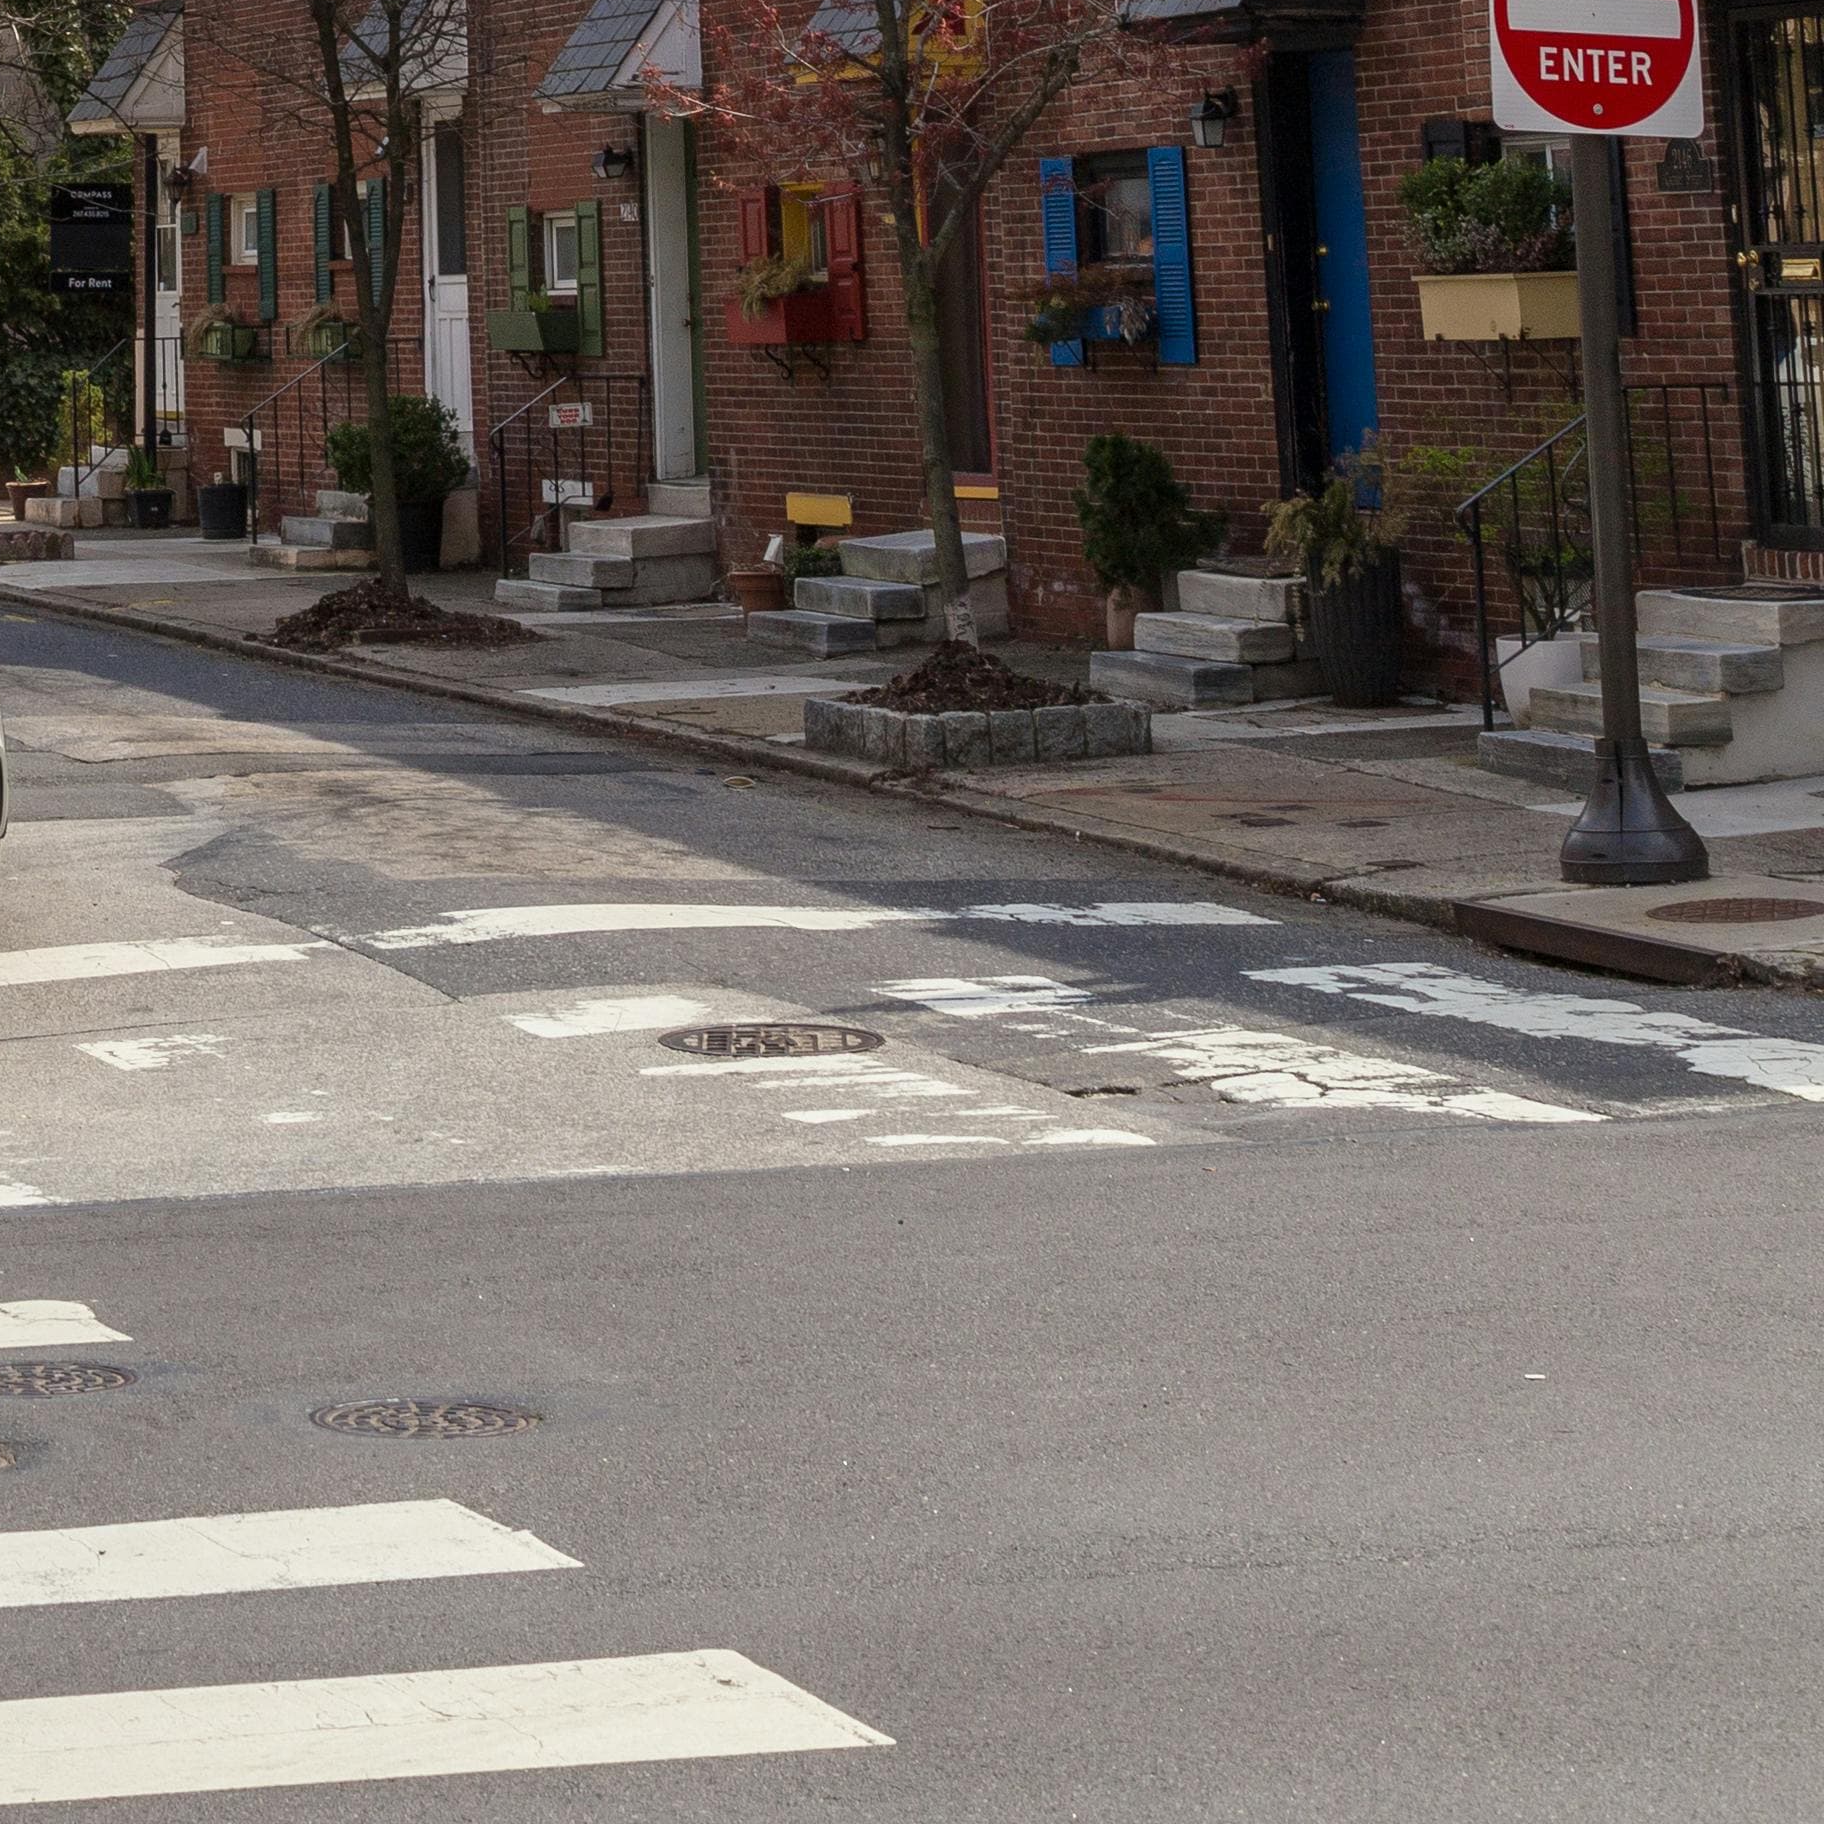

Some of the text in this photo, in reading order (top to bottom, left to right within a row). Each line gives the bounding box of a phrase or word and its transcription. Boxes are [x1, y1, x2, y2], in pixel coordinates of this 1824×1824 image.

[1539, 46, 1653, 87] ENTER
[68, 277, 113, 289] For Rent
